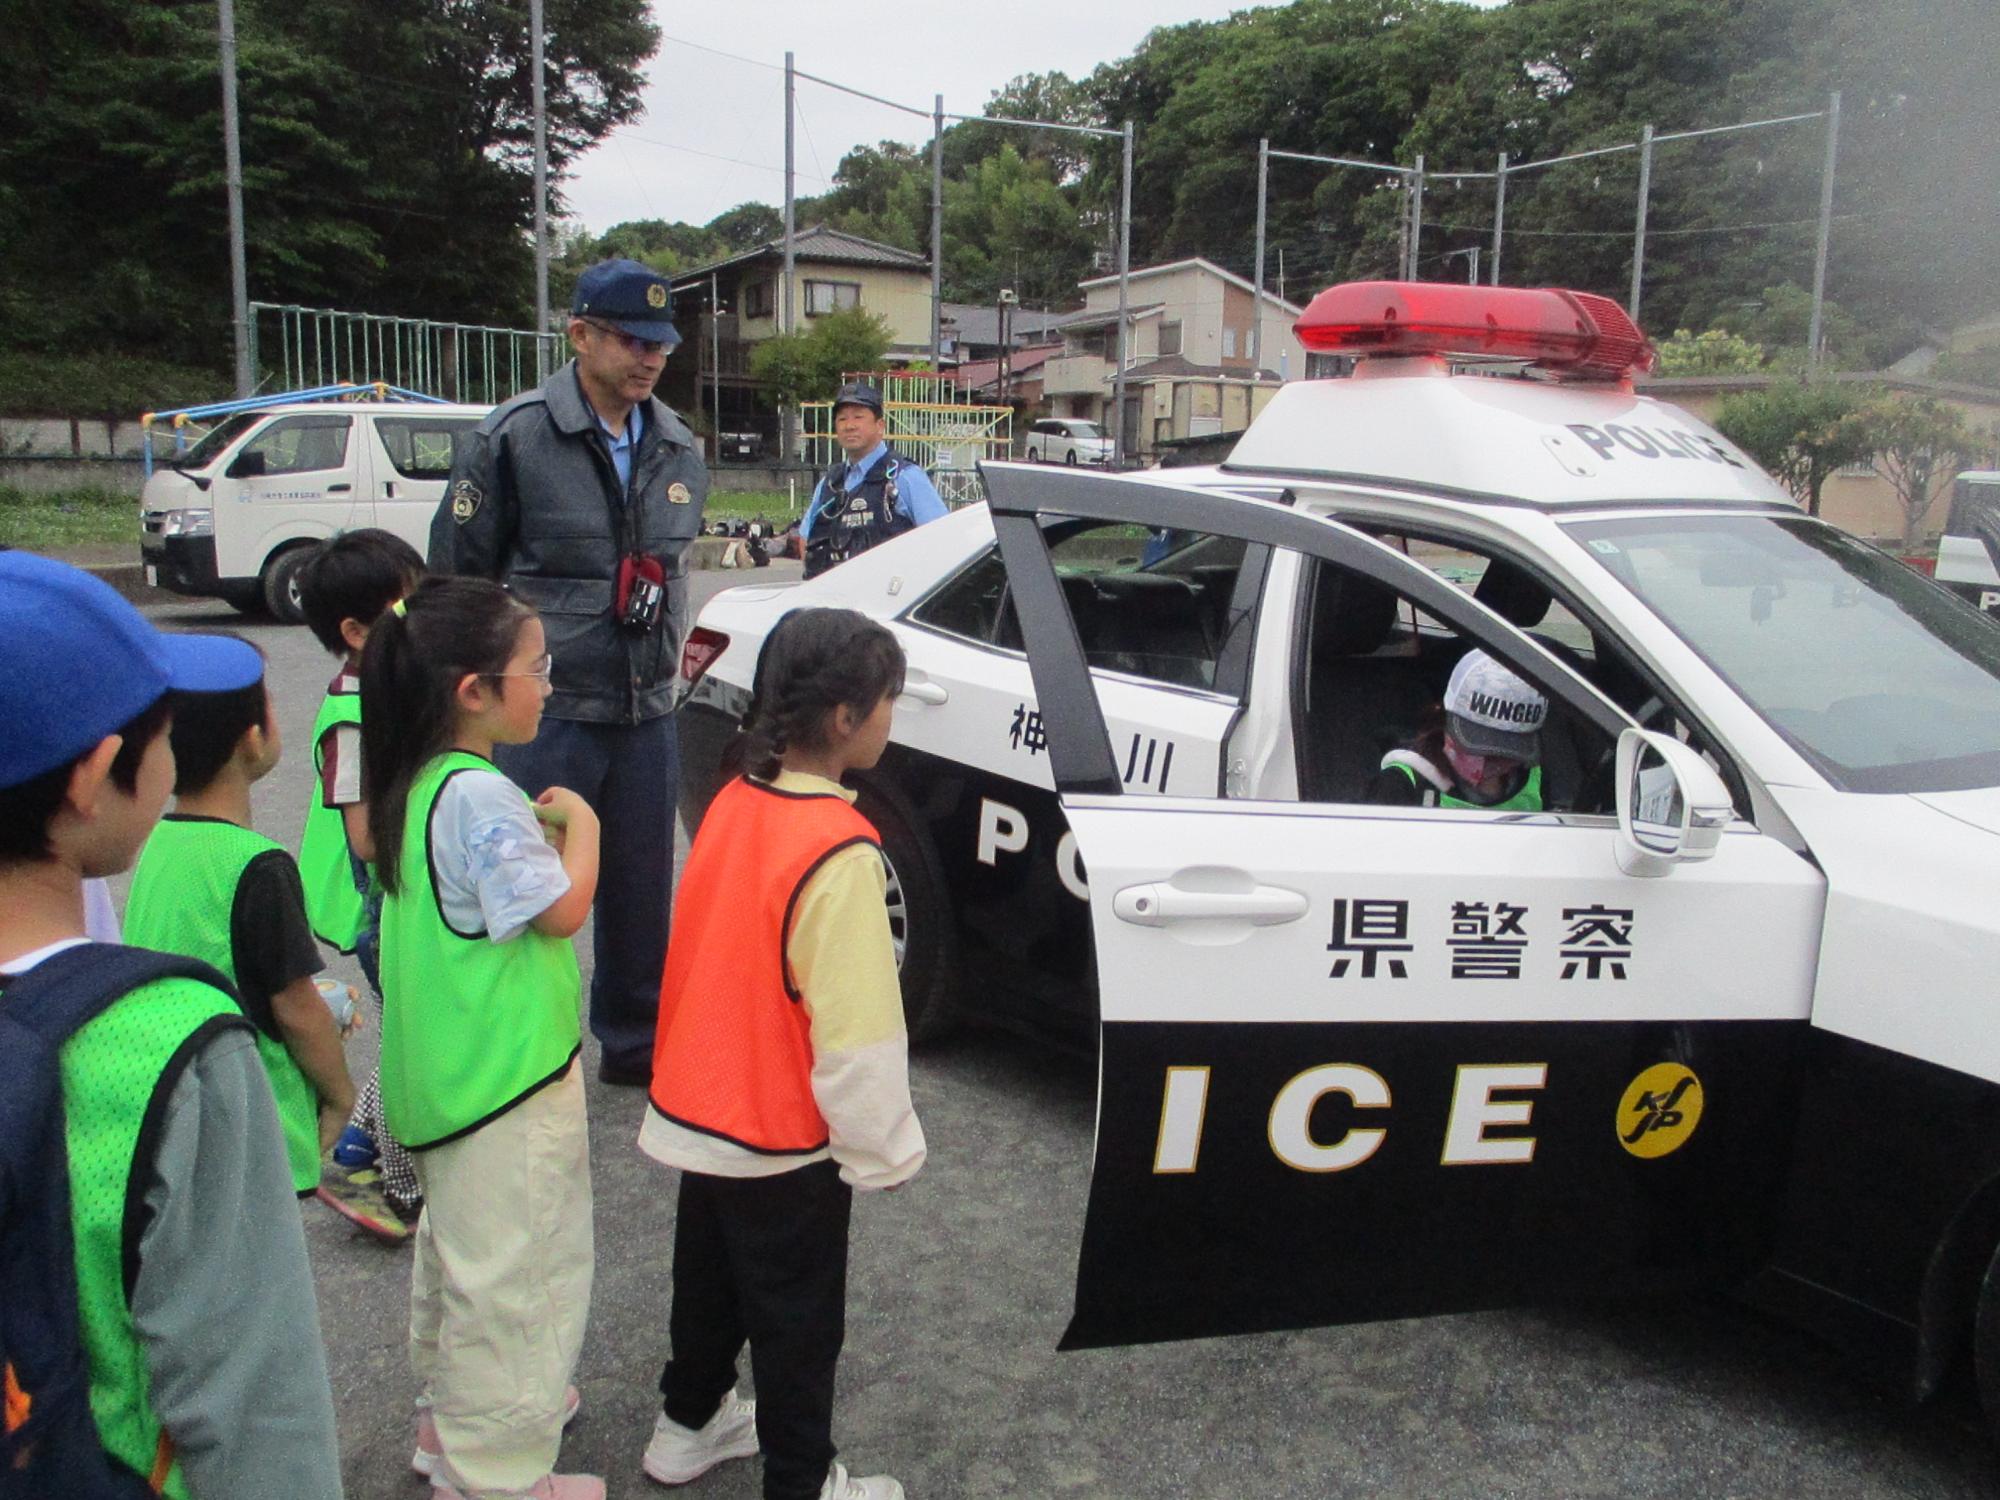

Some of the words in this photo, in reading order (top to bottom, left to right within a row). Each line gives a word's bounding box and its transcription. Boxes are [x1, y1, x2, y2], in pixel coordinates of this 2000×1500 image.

[1566, 424, 1745, 470] POLICE
[1326, 898, 1634, 980] 県警察
